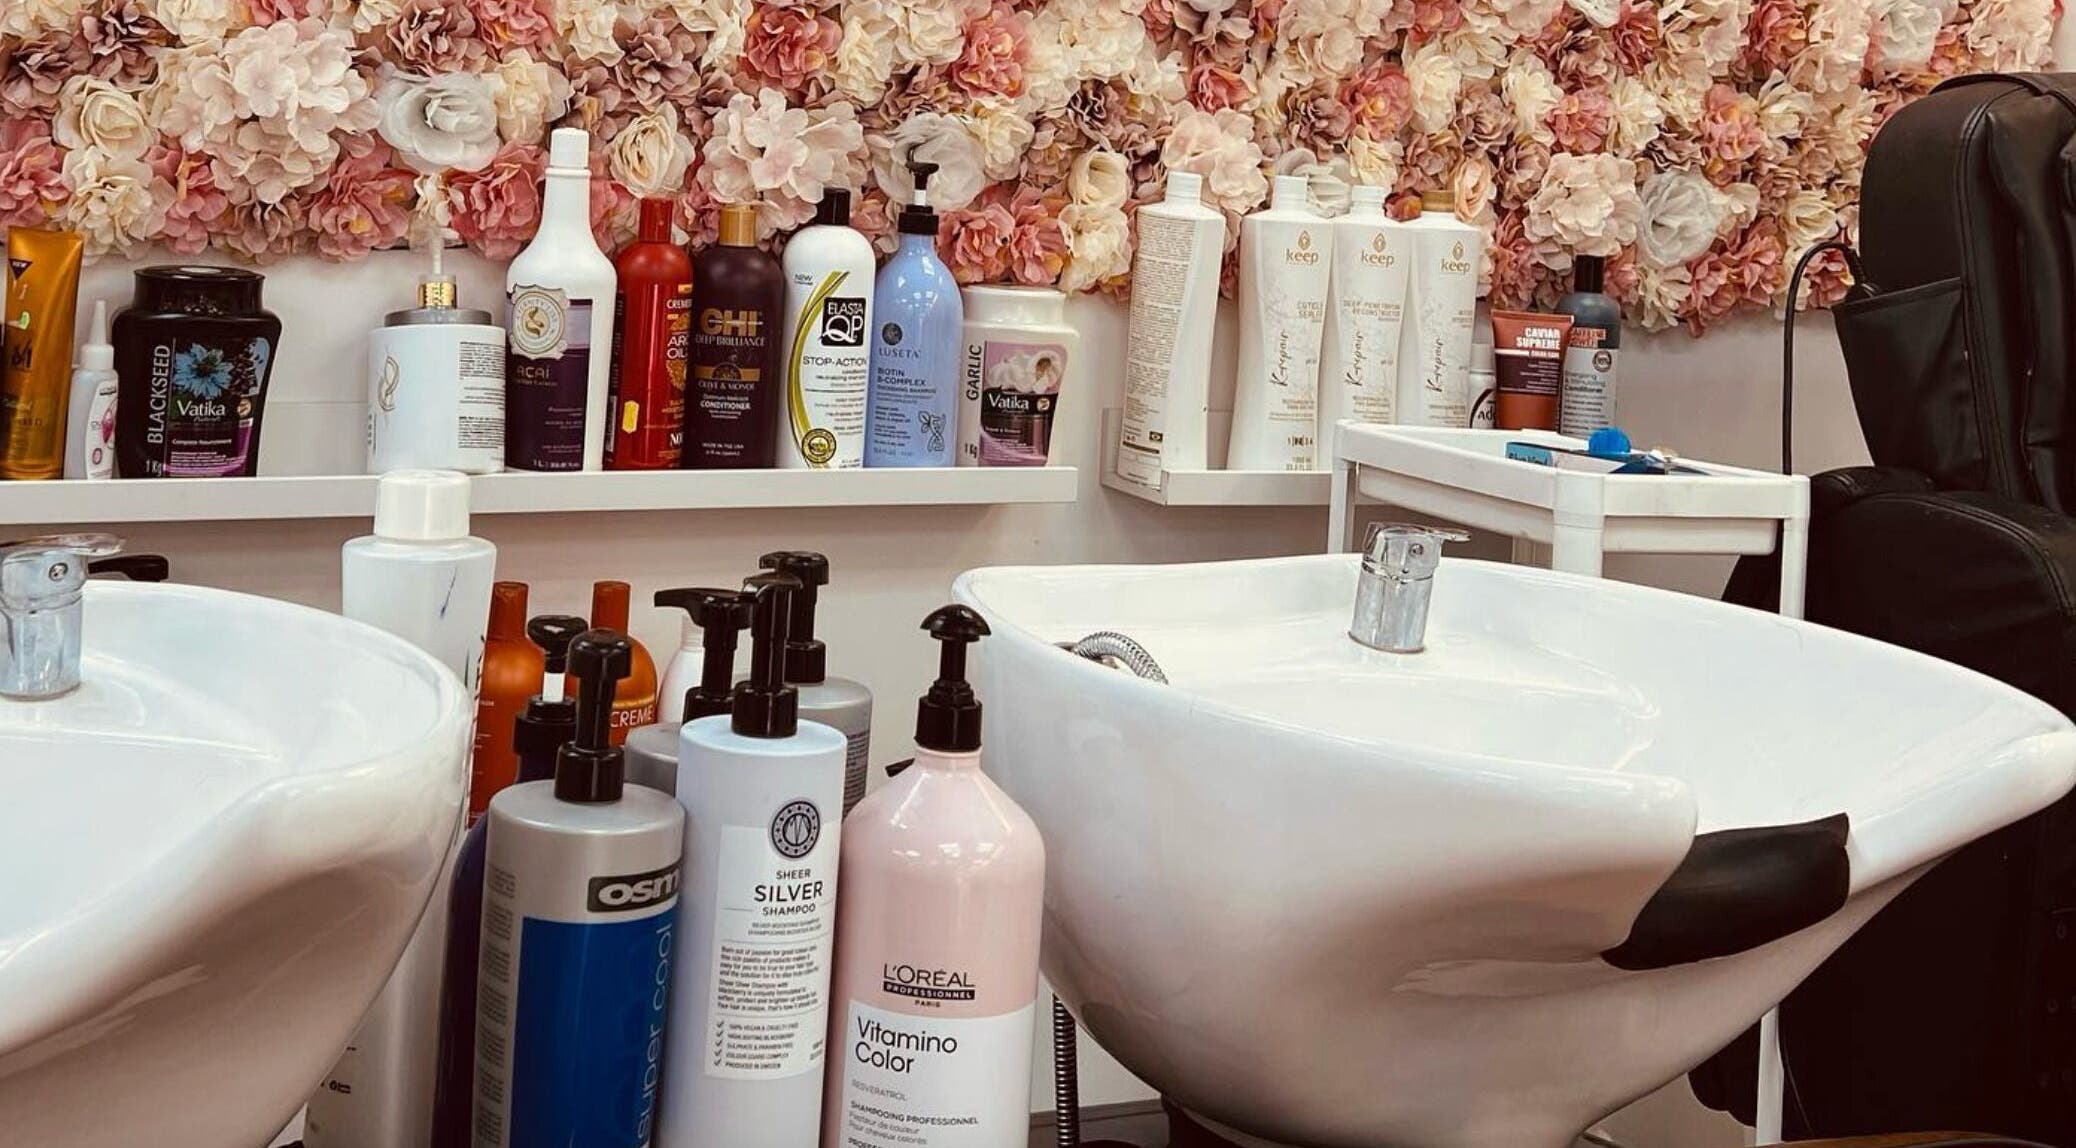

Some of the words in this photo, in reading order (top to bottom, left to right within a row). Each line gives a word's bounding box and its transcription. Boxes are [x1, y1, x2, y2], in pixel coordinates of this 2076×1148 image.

[1286, 248, 1319, 265] keep
[1361, 250, 1395, 266] keep
[1440, 259, 1471, 275] keep
[828, 301, 864, 316] ELASTA
[703, 307, 758, 337] CHI
[1525, 327, 1560, 339] CAVIAR
[1516, 336, 1560, 350] SUPREME
[877, 367, 905, 377] BIOTIN
[966, 345, 982, 401] GARLIC
[147, 344, 171, 444] BLACKSEED
[988, 394, 1030, 411] Vatika
[177, 400, 226, 416] Vatika
[610, 704, 655, 728] CREME
[776, 868, 812, 880] SHEER
[753, 880, 824, 902] SILVER
[762, 903, 816, 917] SHAMPOO
[883, 963, 975, 988] L'ORÉAL
[886, 983, 972, 999] PROFESSIONNEL
[914, 999, 941, 1008] PARIS
[637, 1024, 662, 1140] super
[653, 924, 672, 1011] cool
[857, 1016, 958, 1054] Vitamino
[855, 1041, 915, 1074] Color
[851, 1078, 907, 1101] RESVERATROL
[850, 1100, 905, 1122] SHAMPOOING
[906, 1113, 979, 1126] PROFESSIONNEL
